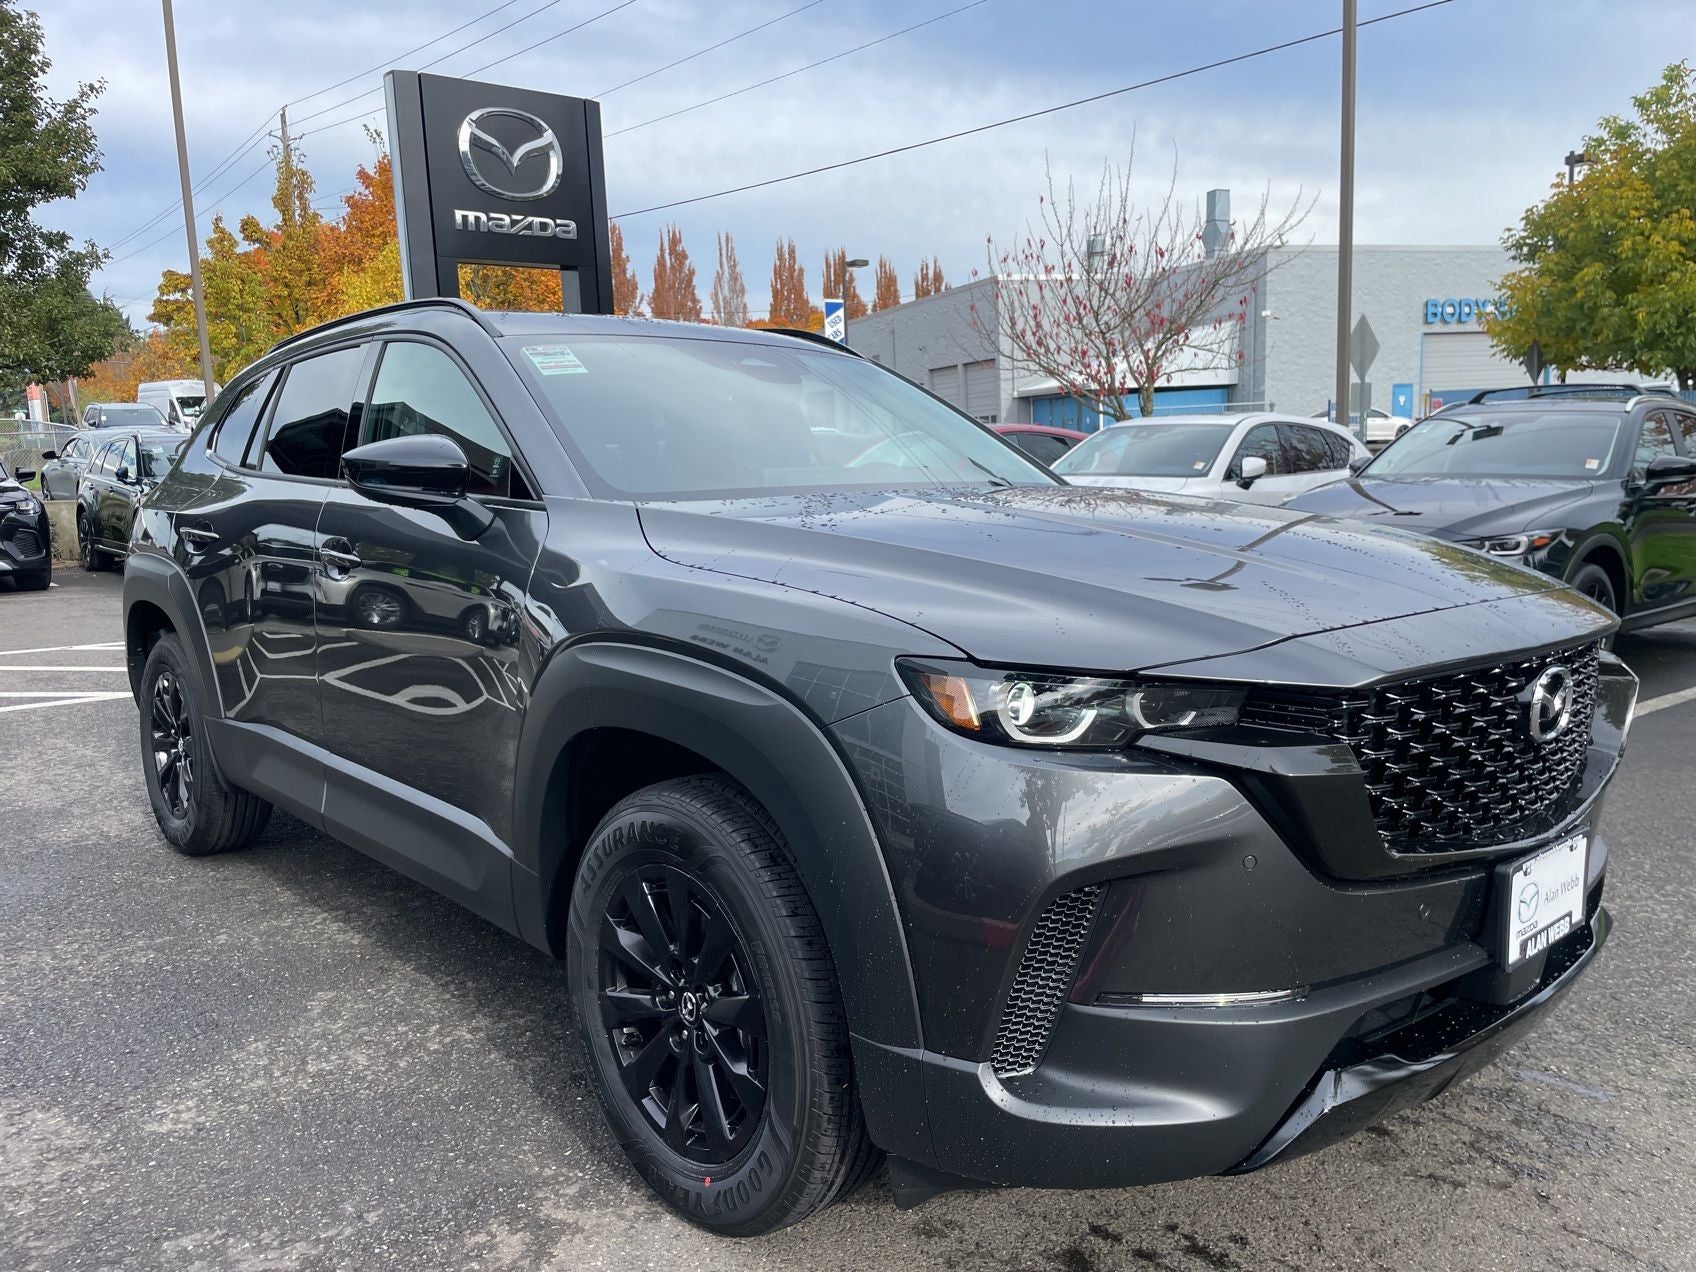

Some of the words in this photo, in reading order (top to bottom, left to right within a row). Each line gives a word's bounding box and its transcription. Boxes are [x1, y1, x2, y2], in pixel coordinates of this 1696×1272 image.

[827, 315, 842, 328] USED
[1425, 298, 1490, 325] BODY
[580, 820, 684, 897] ASSURANCE
[1543, 887, 1559, 905] Alan
[1560, 874, 1580, 895] Webb
[1525, 930, 1547, 959] ALAN
[1548, 916, 1570, 945] WEBB
